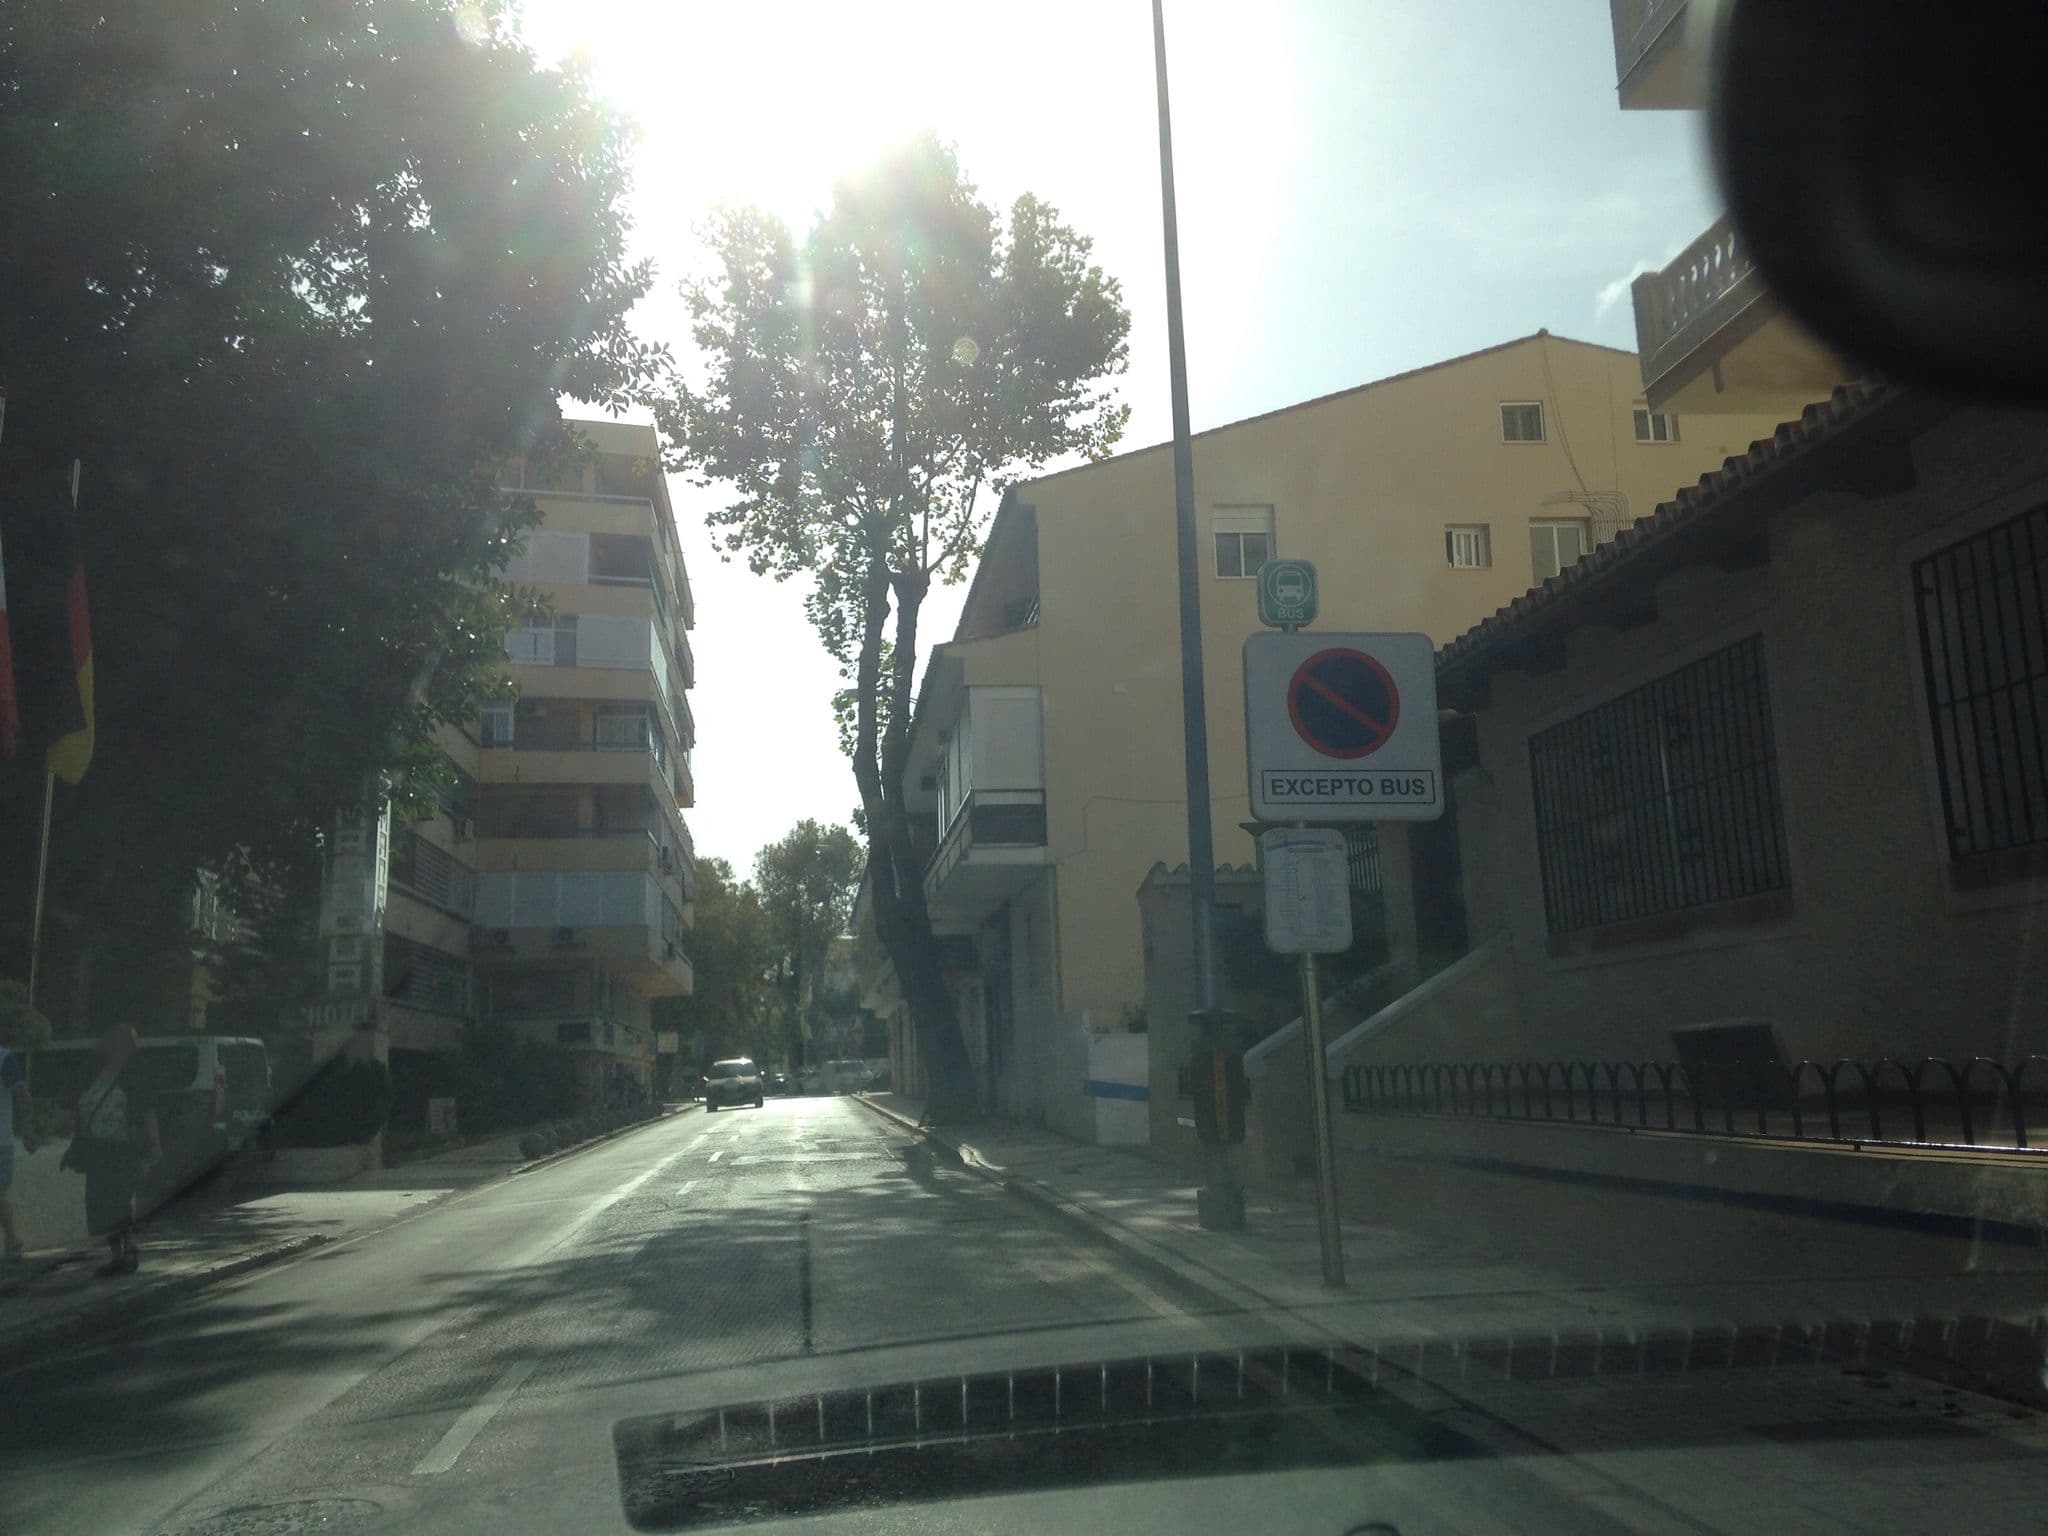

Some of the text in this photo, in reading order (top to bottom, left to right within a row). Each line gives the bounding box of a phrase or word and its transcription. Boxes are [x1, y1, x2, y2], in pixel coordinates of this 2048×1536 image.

[1278, 607, 1305, 619] BUS
[1271, 778, 1426, 796] EXCEPTO BUS
